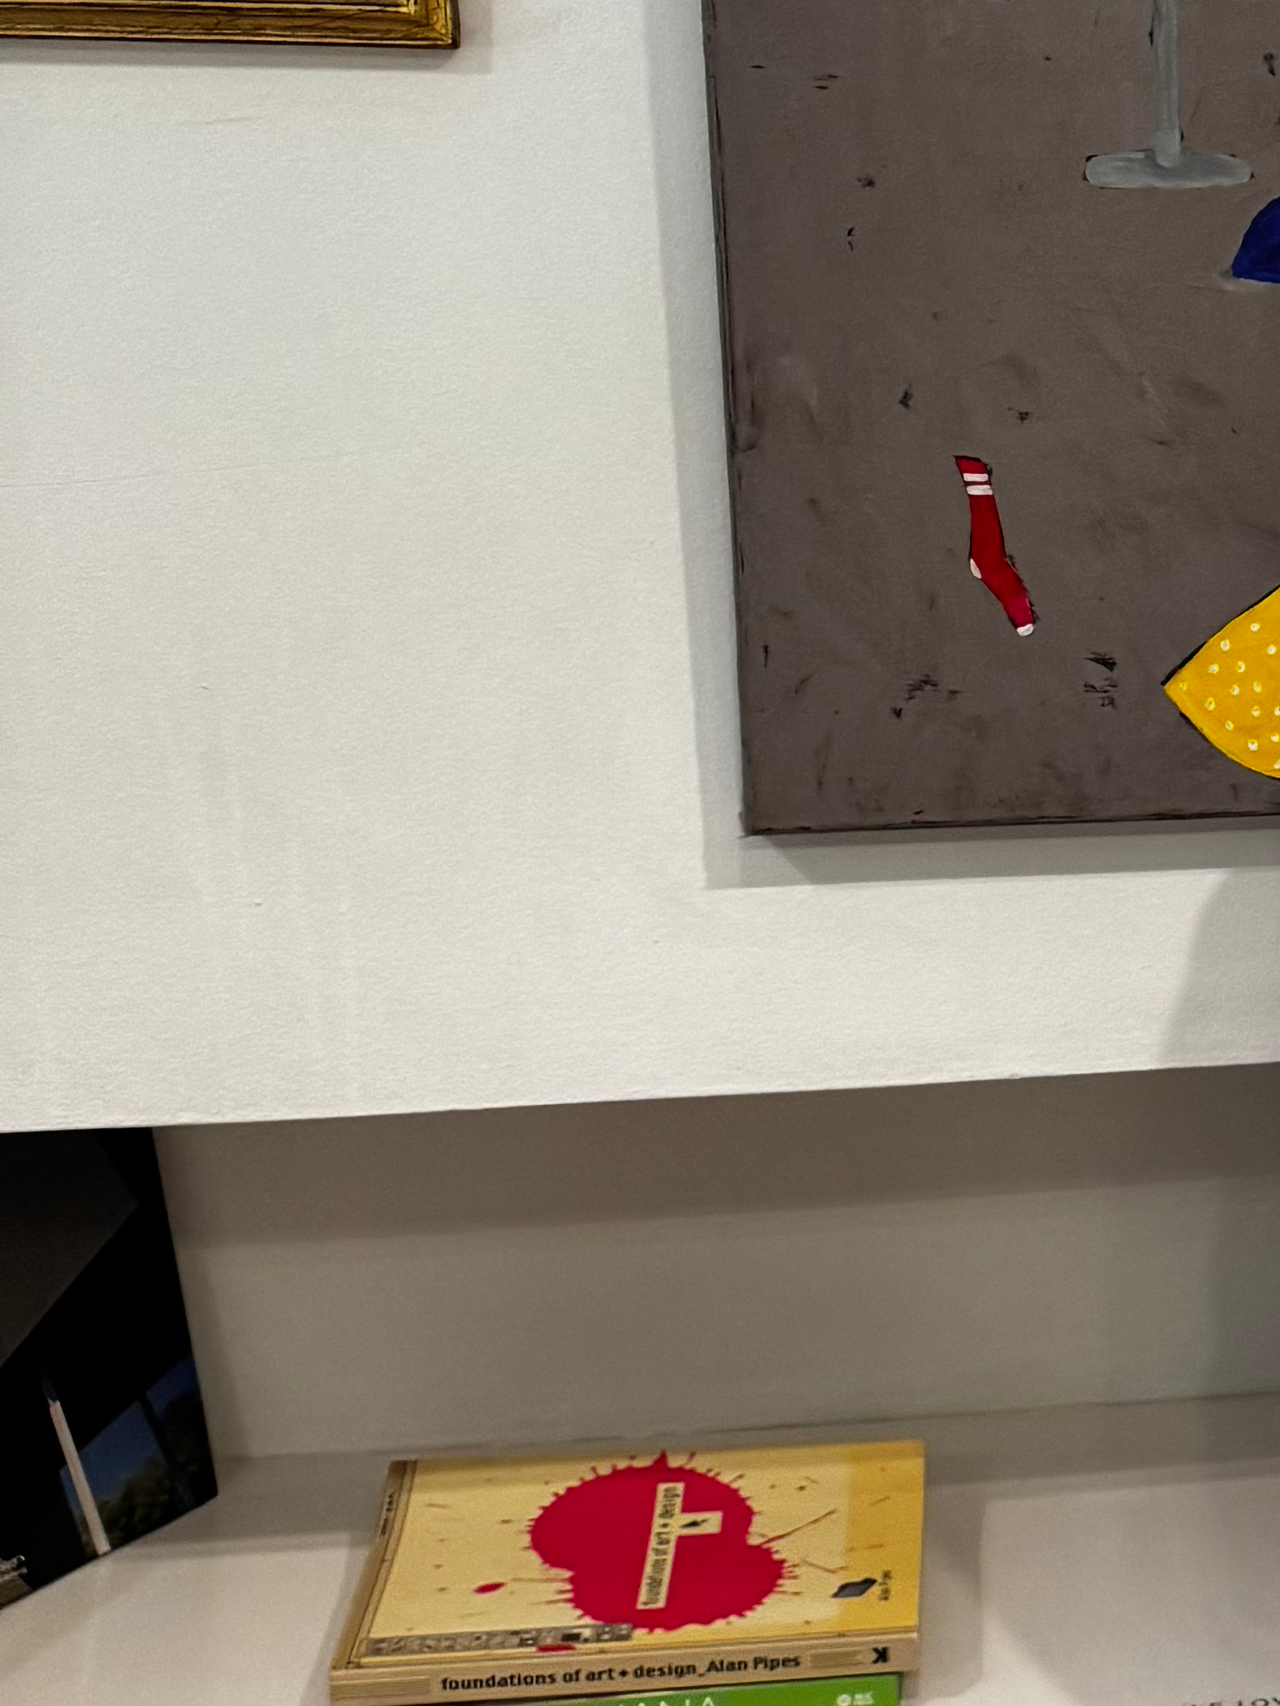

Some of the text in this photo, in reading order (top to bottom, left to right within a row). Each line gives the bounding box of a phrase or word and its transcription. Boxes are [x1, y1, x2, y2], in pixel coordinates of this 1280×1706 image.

[441, 1670, 557, 1691] foundations
[562, 1668, 582, 1683] of
[585, 1666, 614, 1682] art
[752, 1655, 801, 1672] Pipes
